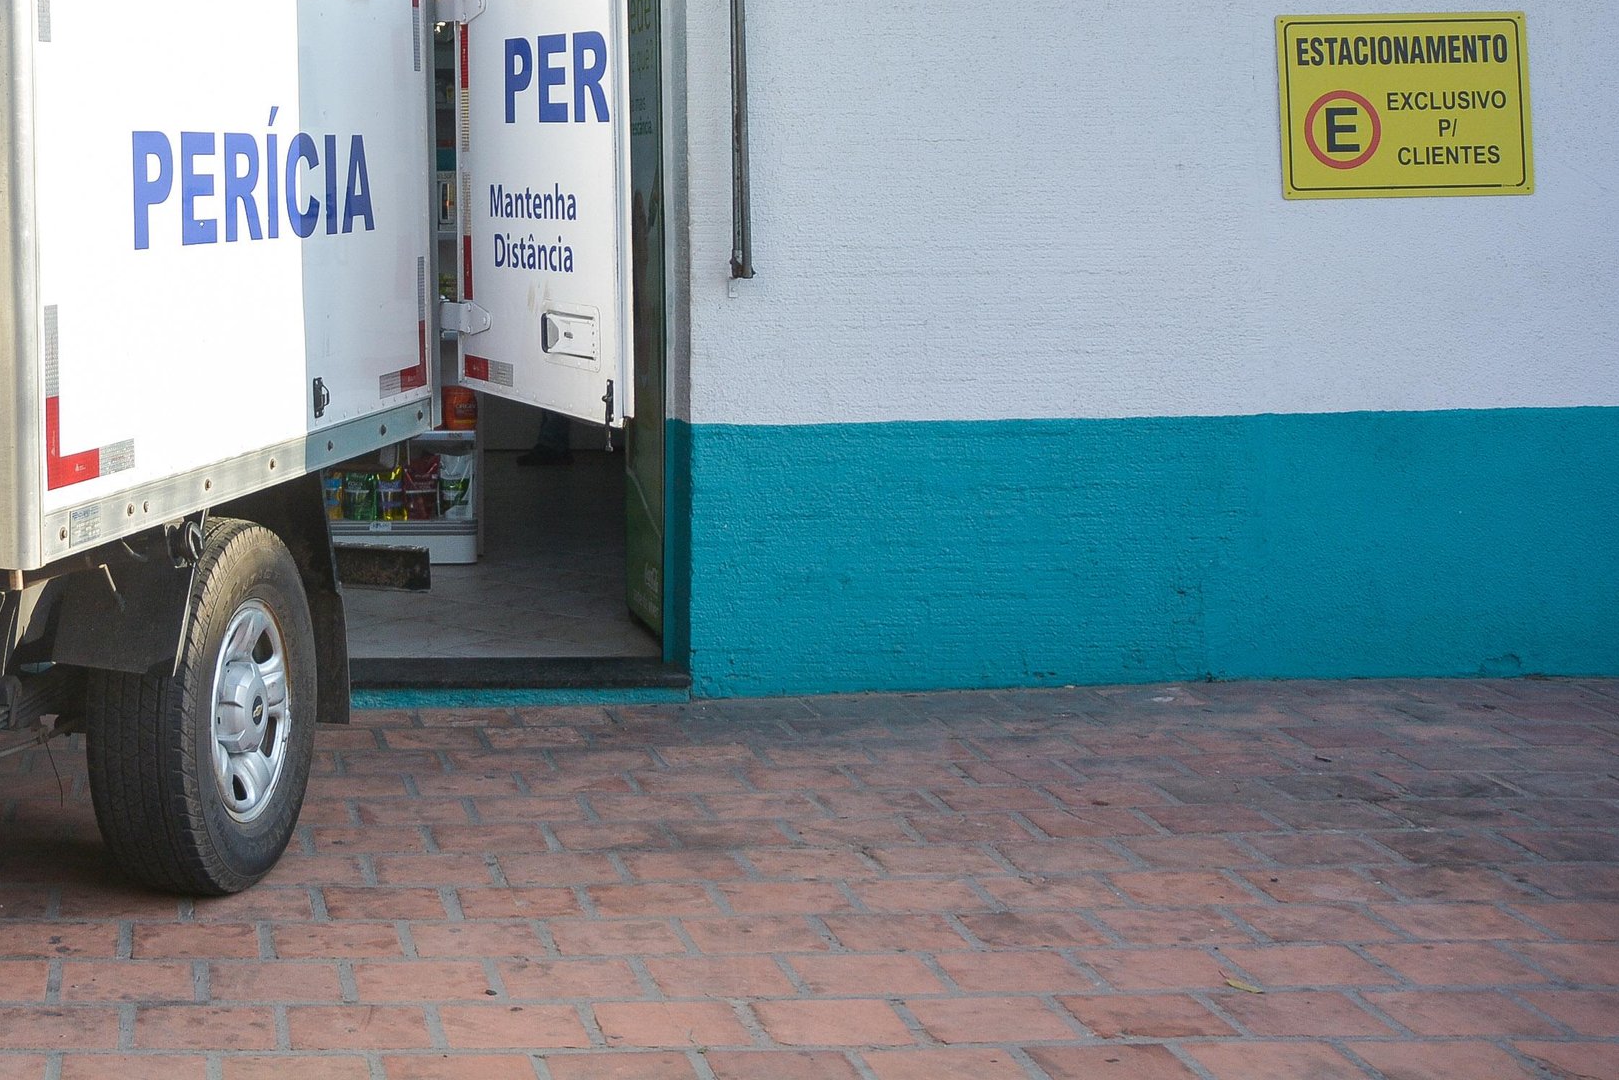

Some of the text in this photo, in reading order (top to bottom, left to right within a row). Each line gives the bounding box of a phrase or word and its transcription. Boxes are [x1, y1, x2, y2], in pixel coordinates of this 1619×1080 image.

[1296, 34, 1508, 66] ESTACIONAMENTO
[504, 30, 610, 124] PER
[1386, 90, 1507, 111] EXCLUSIVO
[1438, 118, 1458, 137] P/
[1397, 145, 1501, 166] CLIENTES
[132, 106, 375, 250] PERÍCIA
[489, 182, 577, 221] Mantenha
[494, 232, 574, 272] Distância
